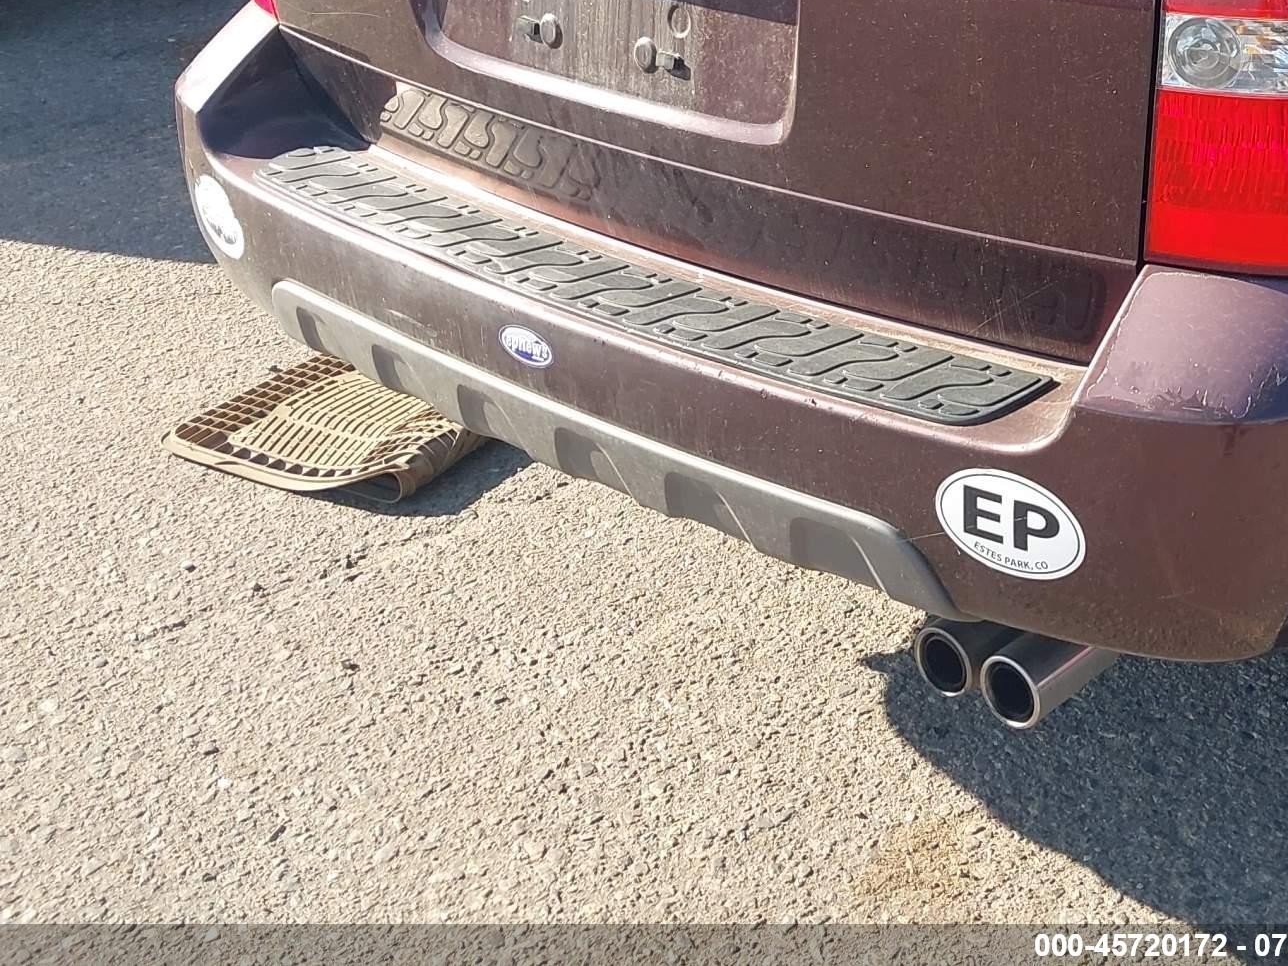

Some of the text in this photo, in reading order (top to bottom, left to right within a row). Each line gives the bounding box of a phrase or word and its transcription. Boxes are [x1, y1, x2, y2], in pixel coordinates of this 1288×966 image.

[963, 484, 1060, 552] EP
[973, 540, 1049, 571] ESTES PARK, CO
